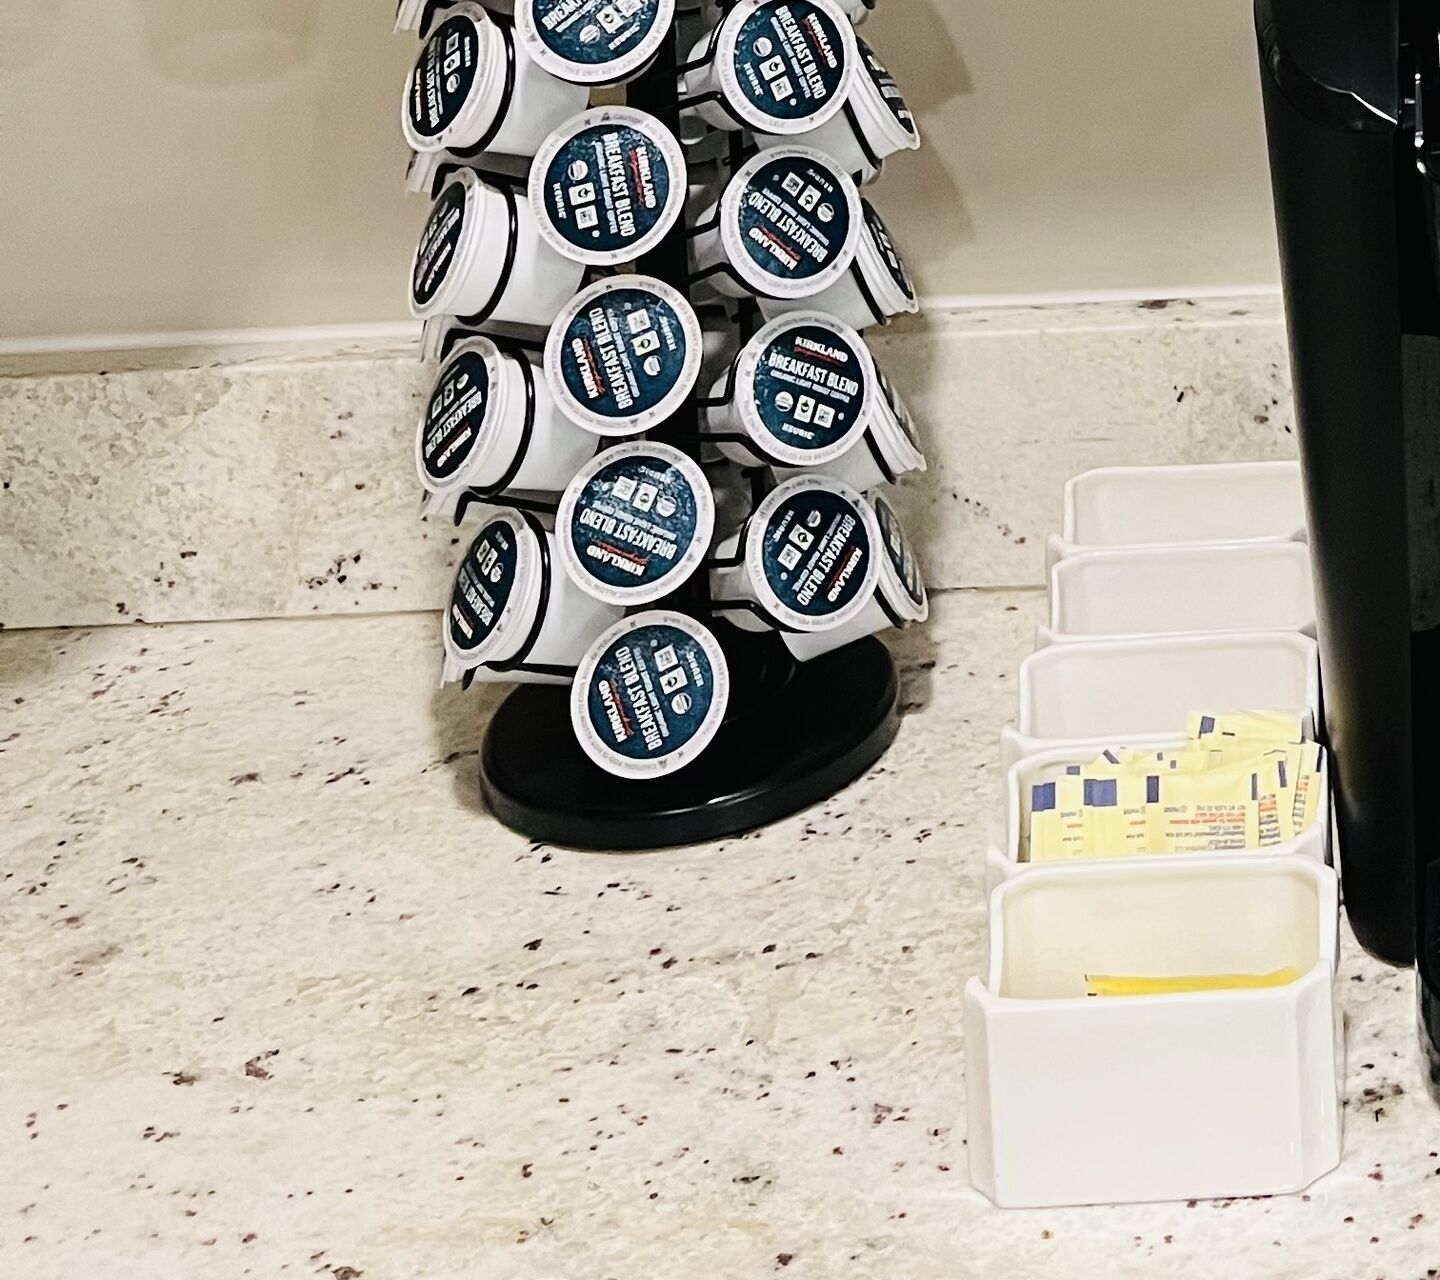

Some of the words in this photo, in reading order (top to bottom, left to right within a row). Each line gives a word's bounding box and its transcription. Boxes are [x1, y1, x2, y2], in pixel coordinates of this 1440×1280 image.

[773, 4, 814, 65] BREAKFAST
[801, 61, 828, 99] BLEND
[806, 11, 839, 69] KIRKLAND
[742, 61, 764, 97] KEURIG
[601, 131, 629, 199] BREAKFAST
[635, 145, 657, 209] KIRKLAND
[552, 182, 567, 220] KEURIG
[614, 197, 636, 237] BLEND
[746, 189, 783, 223] BLEND
[747, 225, 798, 270] KIRKLAND
[775, 212, 830, 263] BREAKFAST
[587, 305, 613, 346] BLEND
[570, 336, 599, 399] KIRKLAND
[794, 335, 849, 363] KIRKLAND
[598, 342, 634, 410] BREAKFAST
[766, 351, 828, 384] BREAKFAST
[825, 371, 859, 397] BLEND
[577, 506, 617, 535] BLEND
[611, 520, 678, 561] BREAKFAST
[584, 542, 645, 577] KIRKLAND
[815, 513, 857, 574] BREAKFAST
[794, 567, 826, 607] BLEND
[825, 546, 864, 603] KIRKLAND
[613, 645, 641, 686] BLEND
[596, 678, 628, 743] KIRKLAND
[626, 682, 664, 751] BREAKFAST
